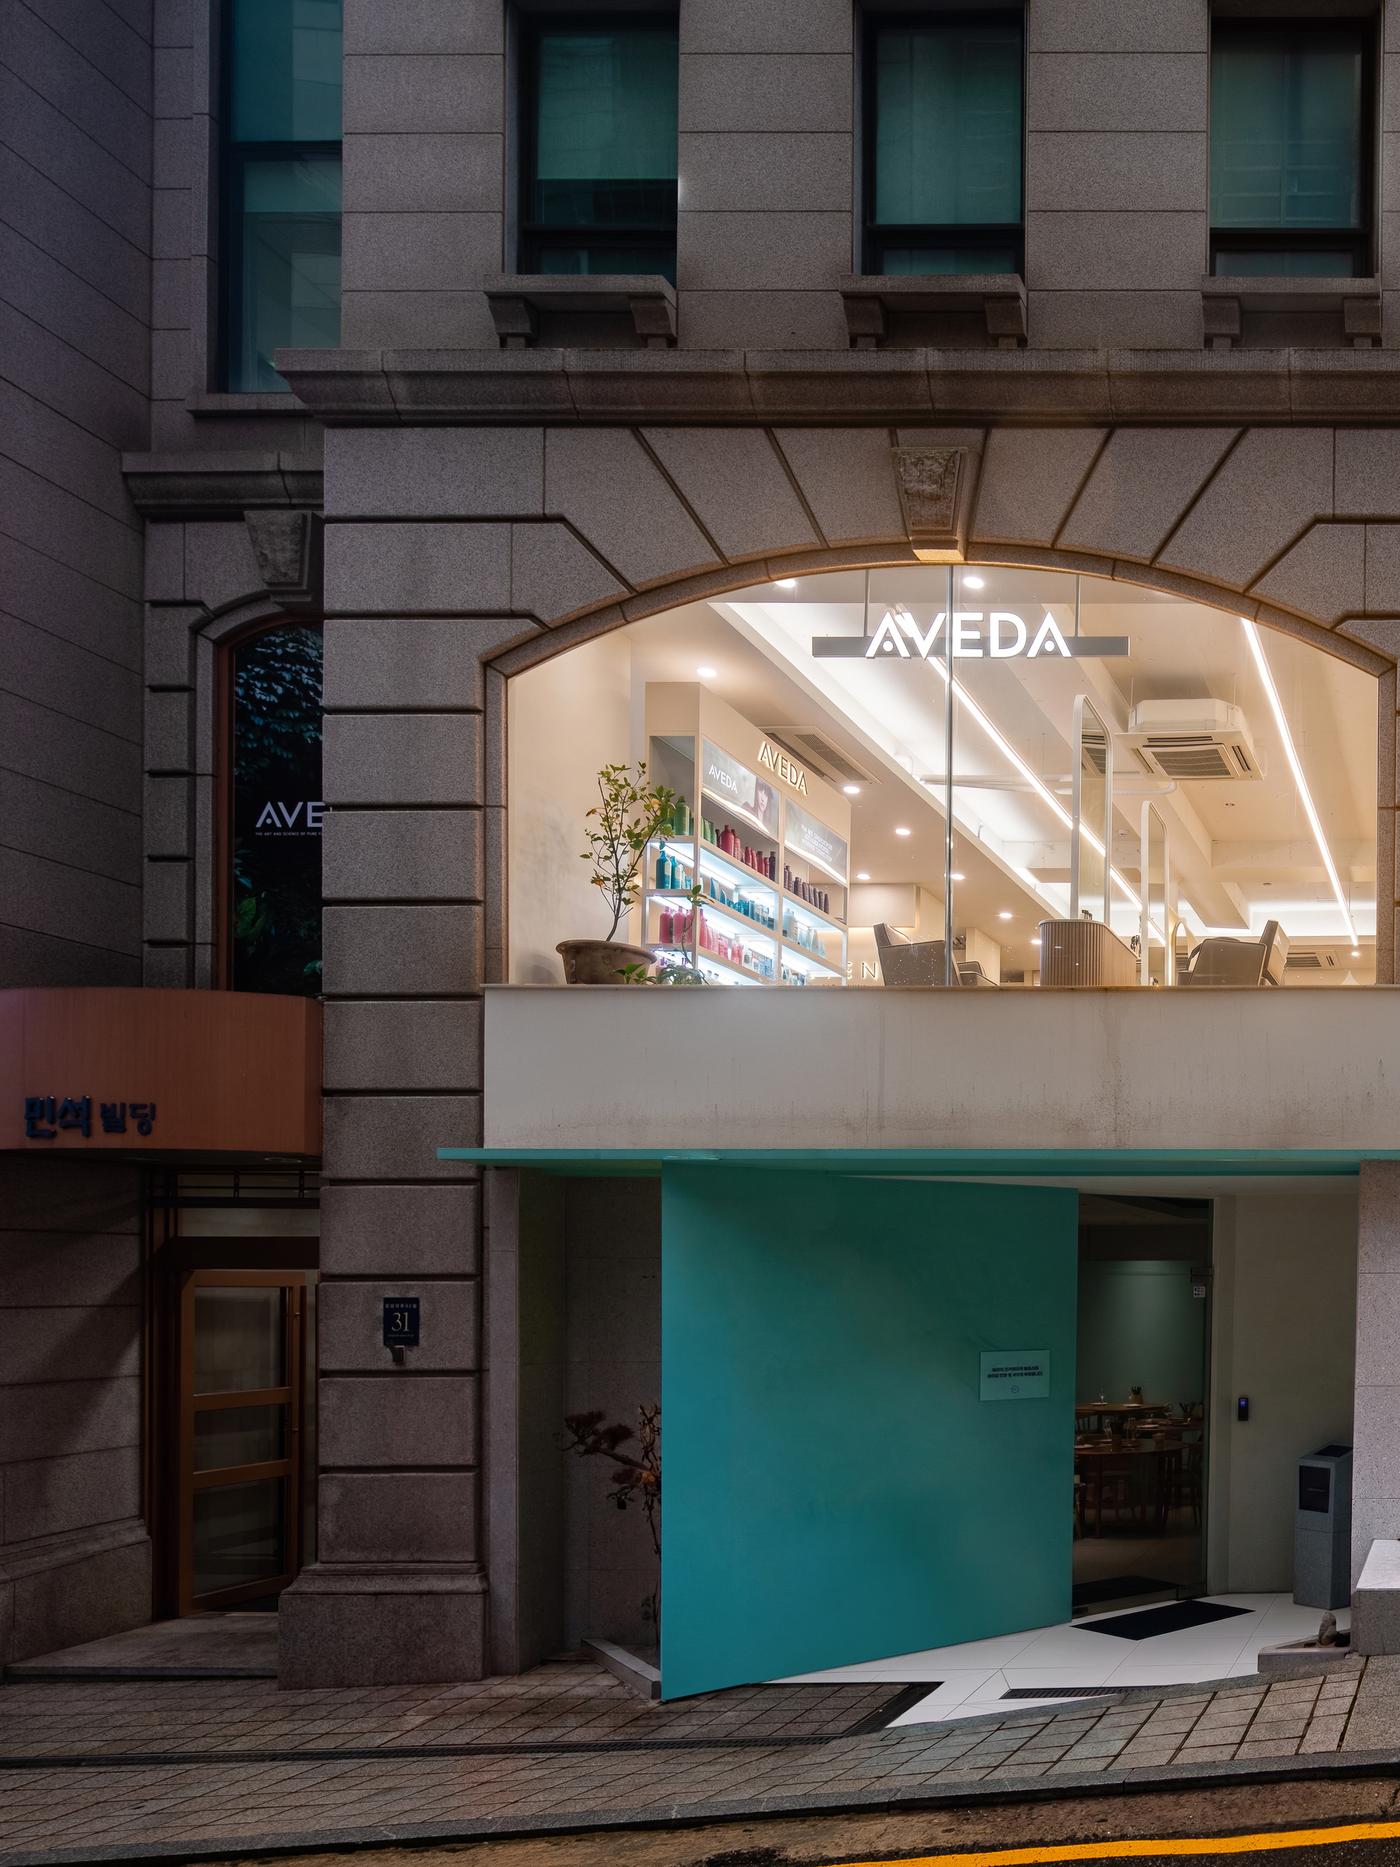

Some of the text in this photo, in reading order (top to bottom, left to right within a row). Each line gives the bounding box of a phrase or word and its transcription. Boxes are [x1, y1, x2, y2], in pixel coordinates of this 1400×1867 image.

[864, 611, 1073, 660] AVEDA
[708, 763, 738, 795] AVEDA
[757, 741, 808, 796] AVEDA
[24, 1095, 157, 1138] 민석 빌딩
[391, 1311, 410, 1332] 31
